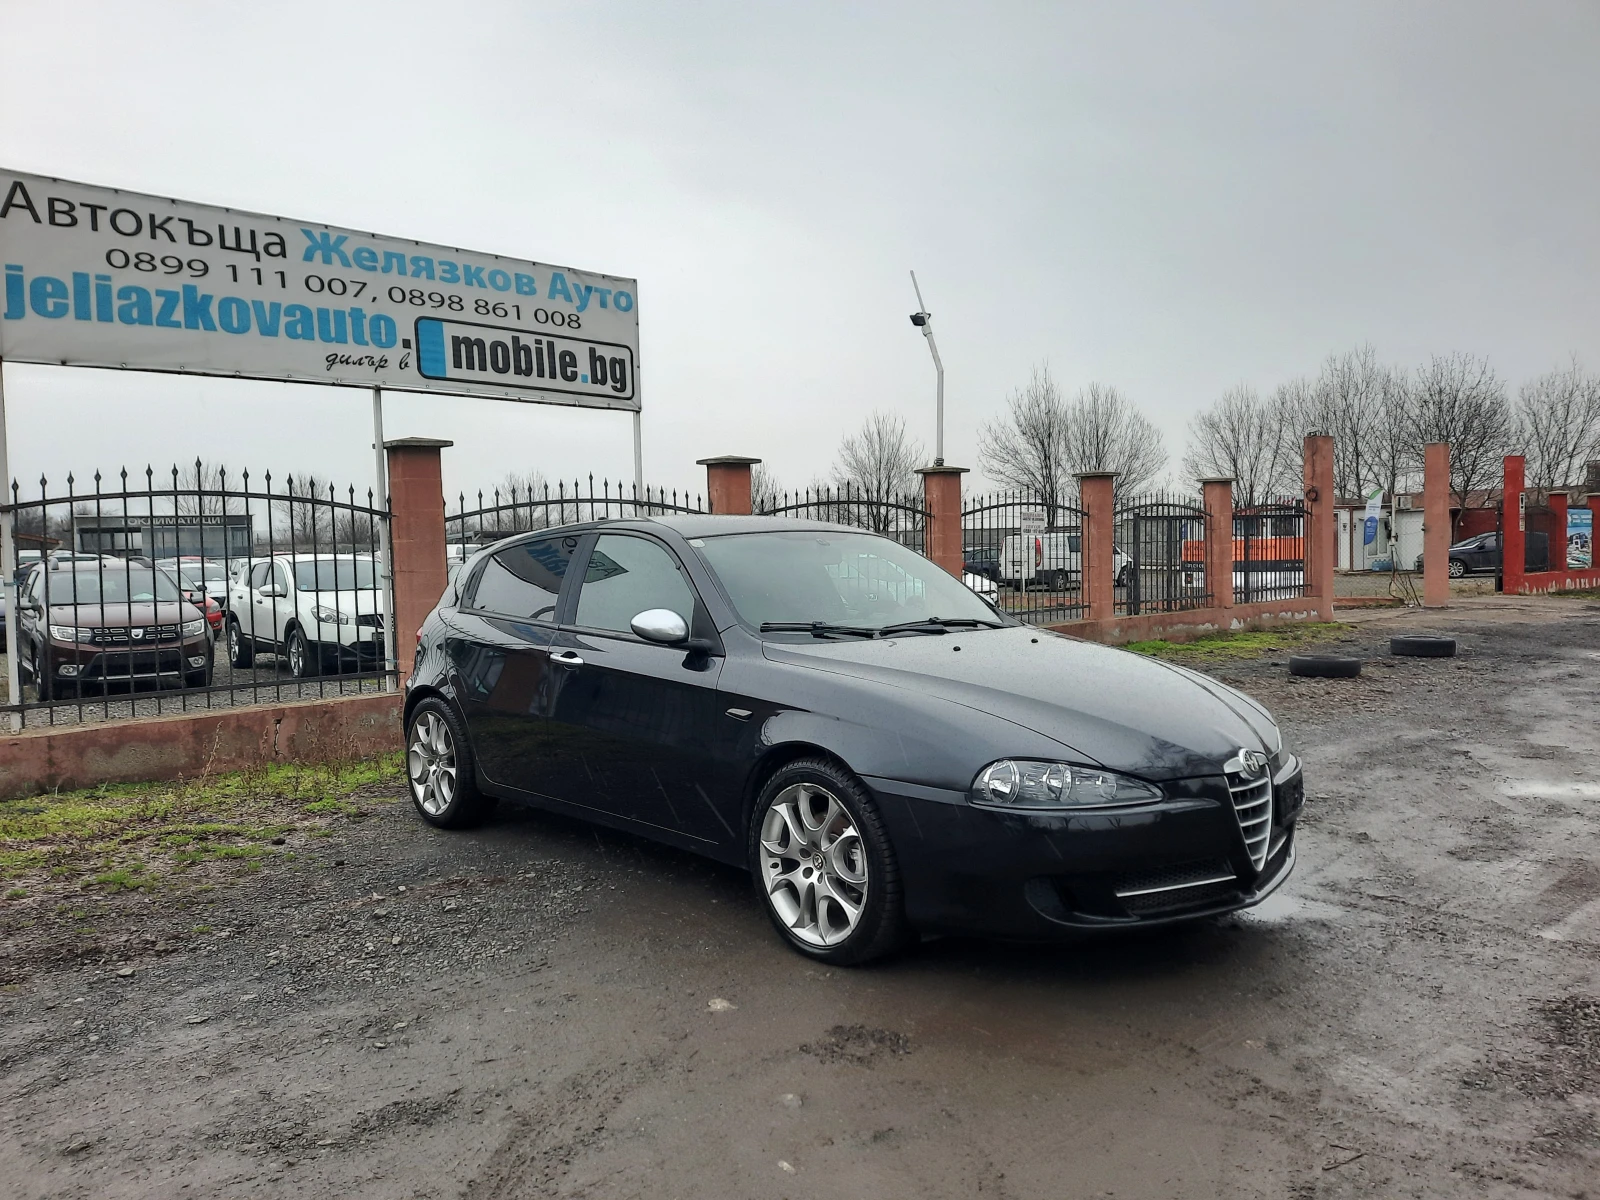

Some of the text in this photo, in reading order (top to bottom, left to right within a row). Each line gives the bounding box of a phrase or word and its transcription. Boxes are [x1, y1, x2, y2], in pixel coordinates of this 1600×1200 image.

[0, 180, 634, 313] Автокъща Желязков Ауто
[105, 248, 582, 330] 0899 111 007, 0898 861 008
[325, 352, 389, 373] дилър
[451, 334, 627, 393] mobile.bg
